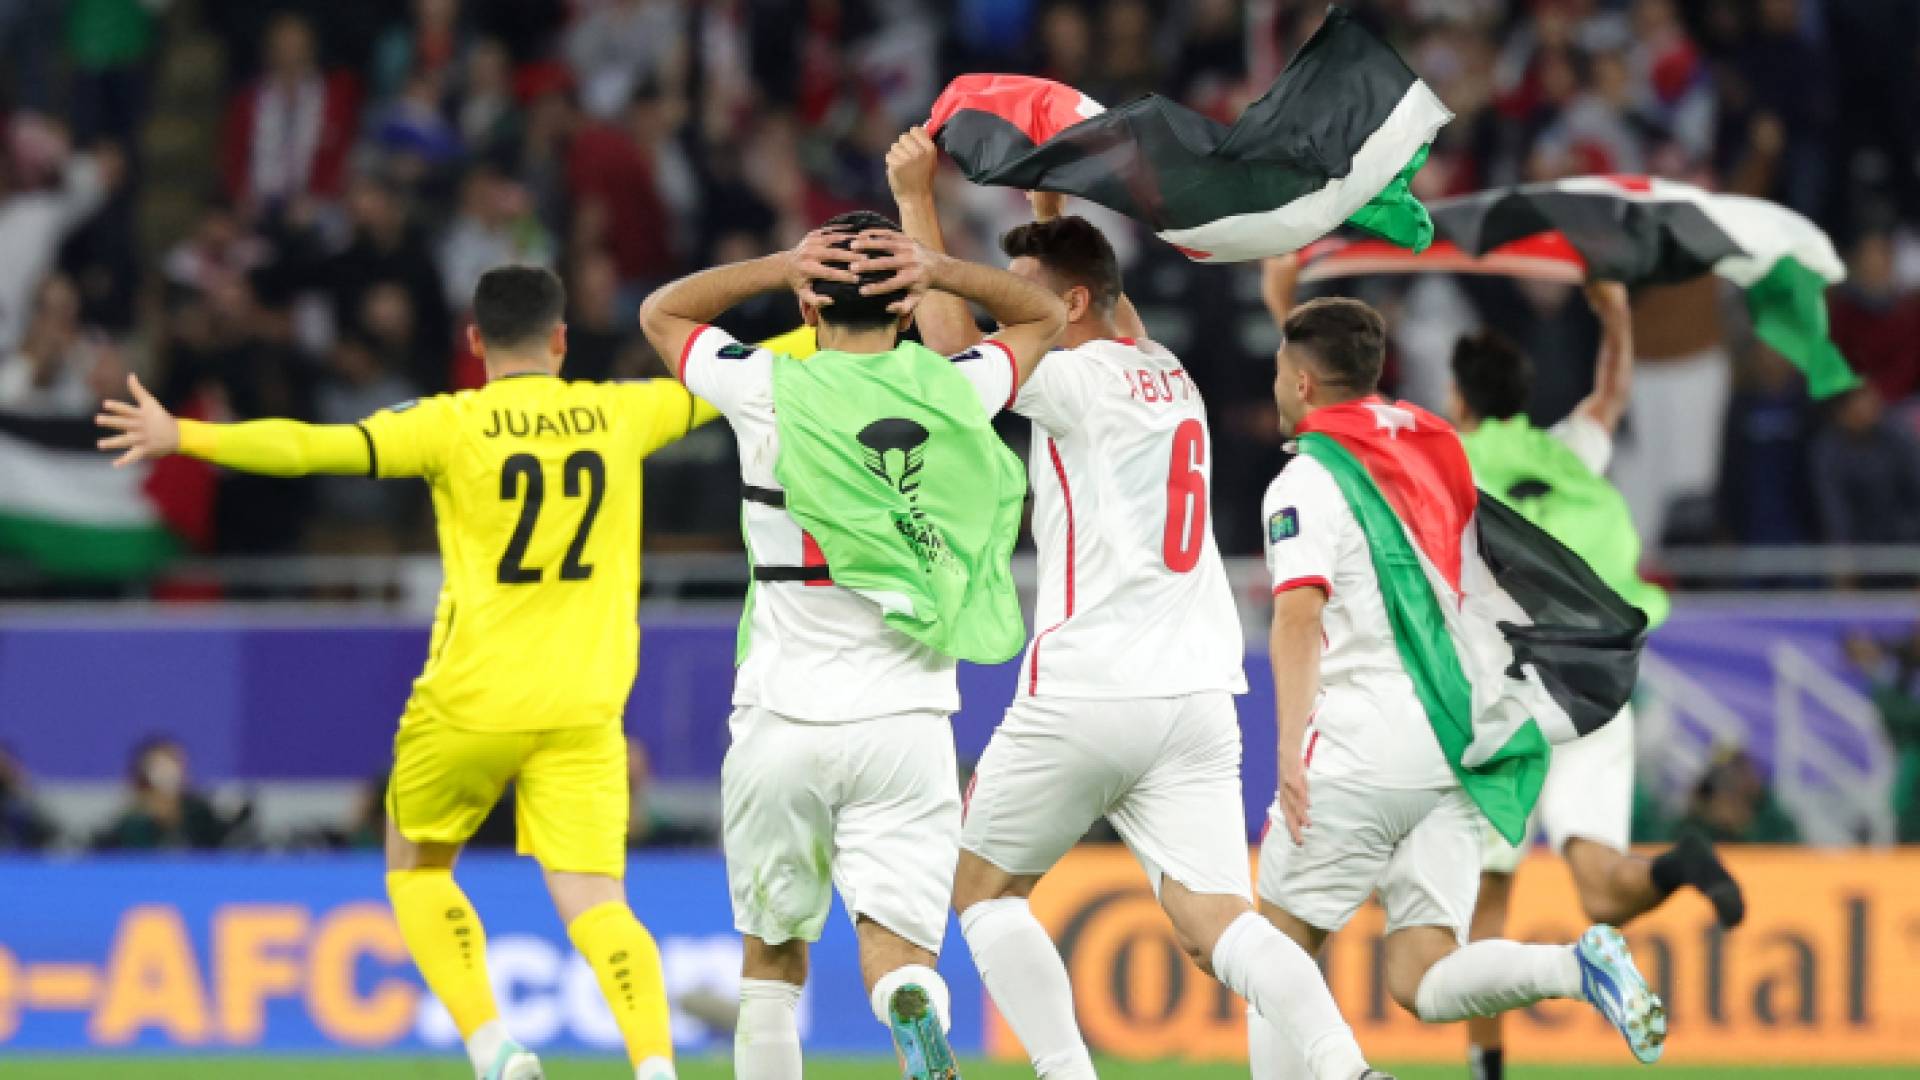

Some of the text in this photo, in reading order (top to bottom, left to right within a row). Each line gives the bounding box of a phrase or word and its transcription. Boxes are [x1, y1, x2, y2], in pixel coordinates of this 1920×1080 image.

[483, 406, 607, 437] JUAIDI
[497, 449, 606, 584] 22
[1164, 418, 1206, 573] 6
[0, 903, 812, 1046] -AFC.c
[1052, 886, 1882, 1058] Coital
